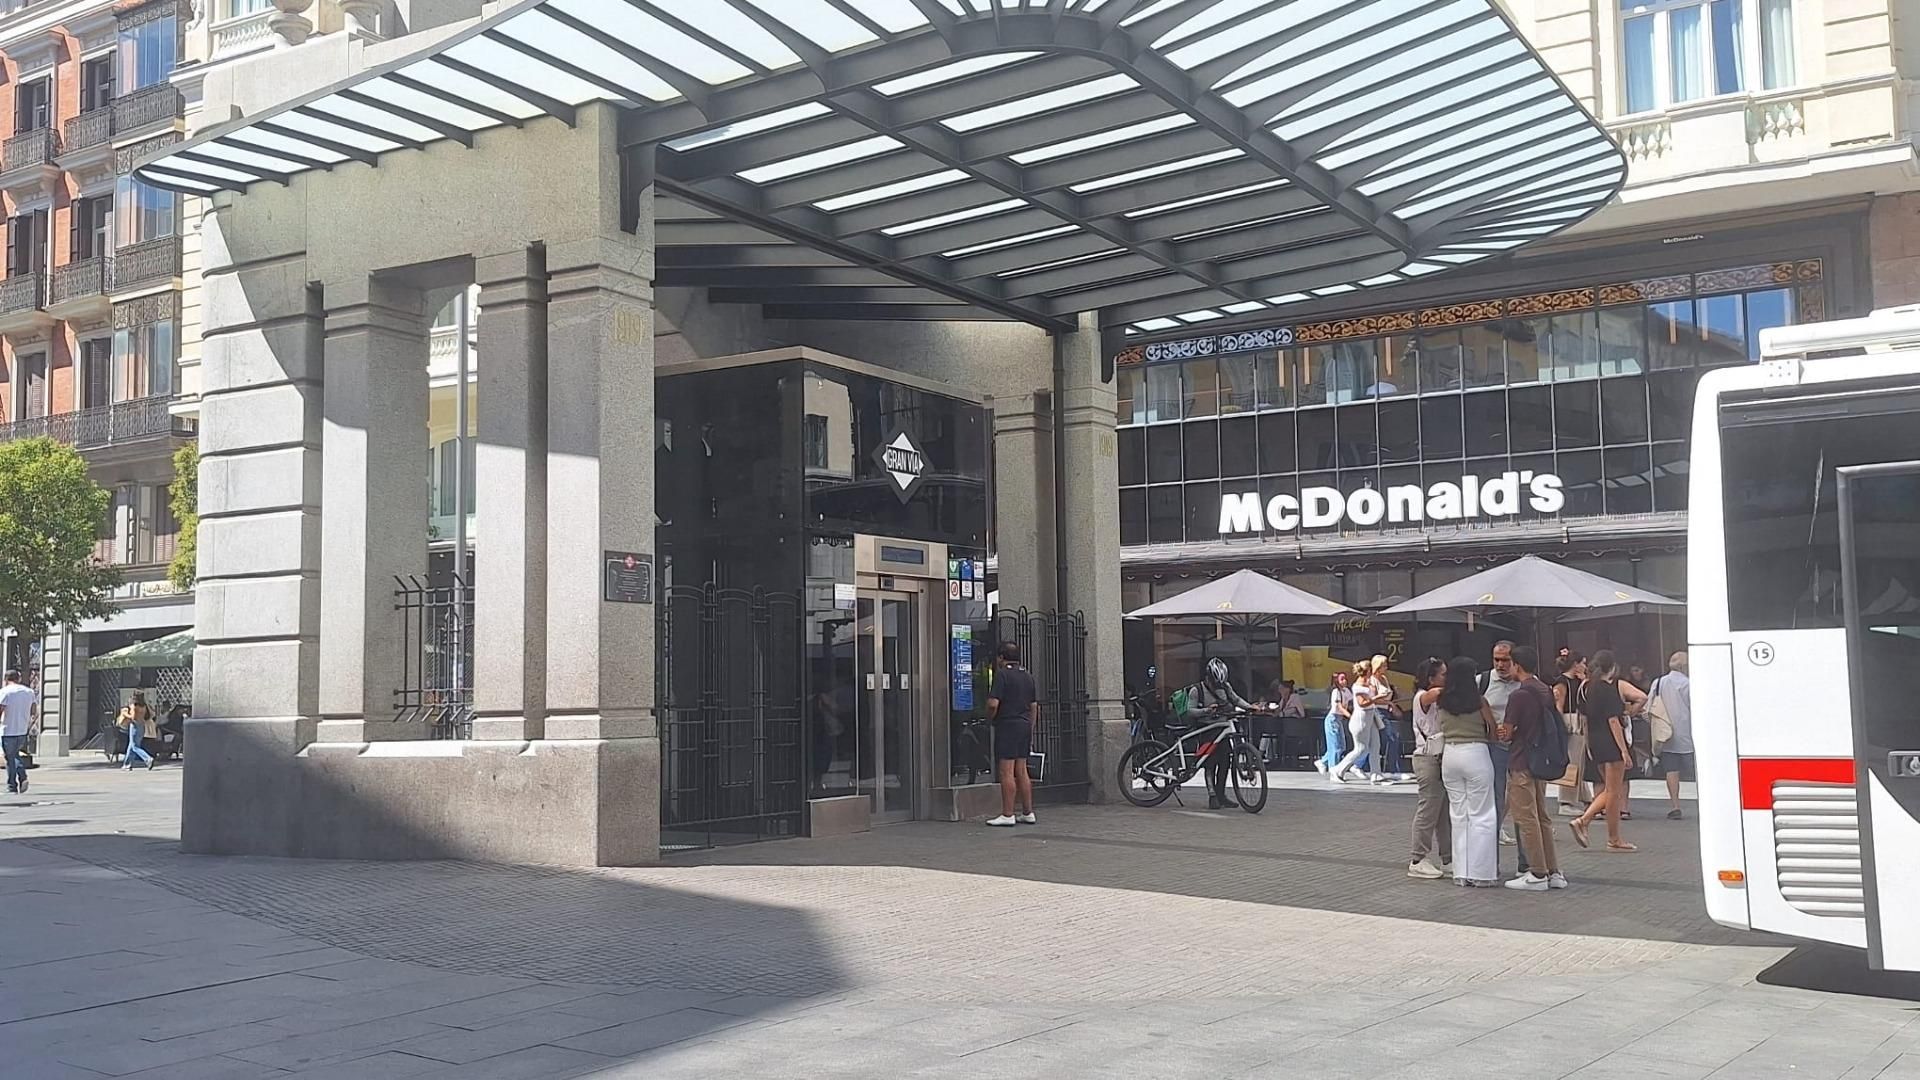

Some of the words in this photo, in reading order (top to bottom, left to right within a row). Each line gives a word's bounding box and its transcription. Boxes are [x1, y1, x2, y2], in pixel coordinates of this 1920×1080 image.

[888, 448, 907, 471] GRAN
[907, 452, 920, 475] VIA
[1218, 470, 1565, 534] McDonald's
[1333, 616, 1371, 633] McCafé
[1753, 648, 1770, 659] 15
